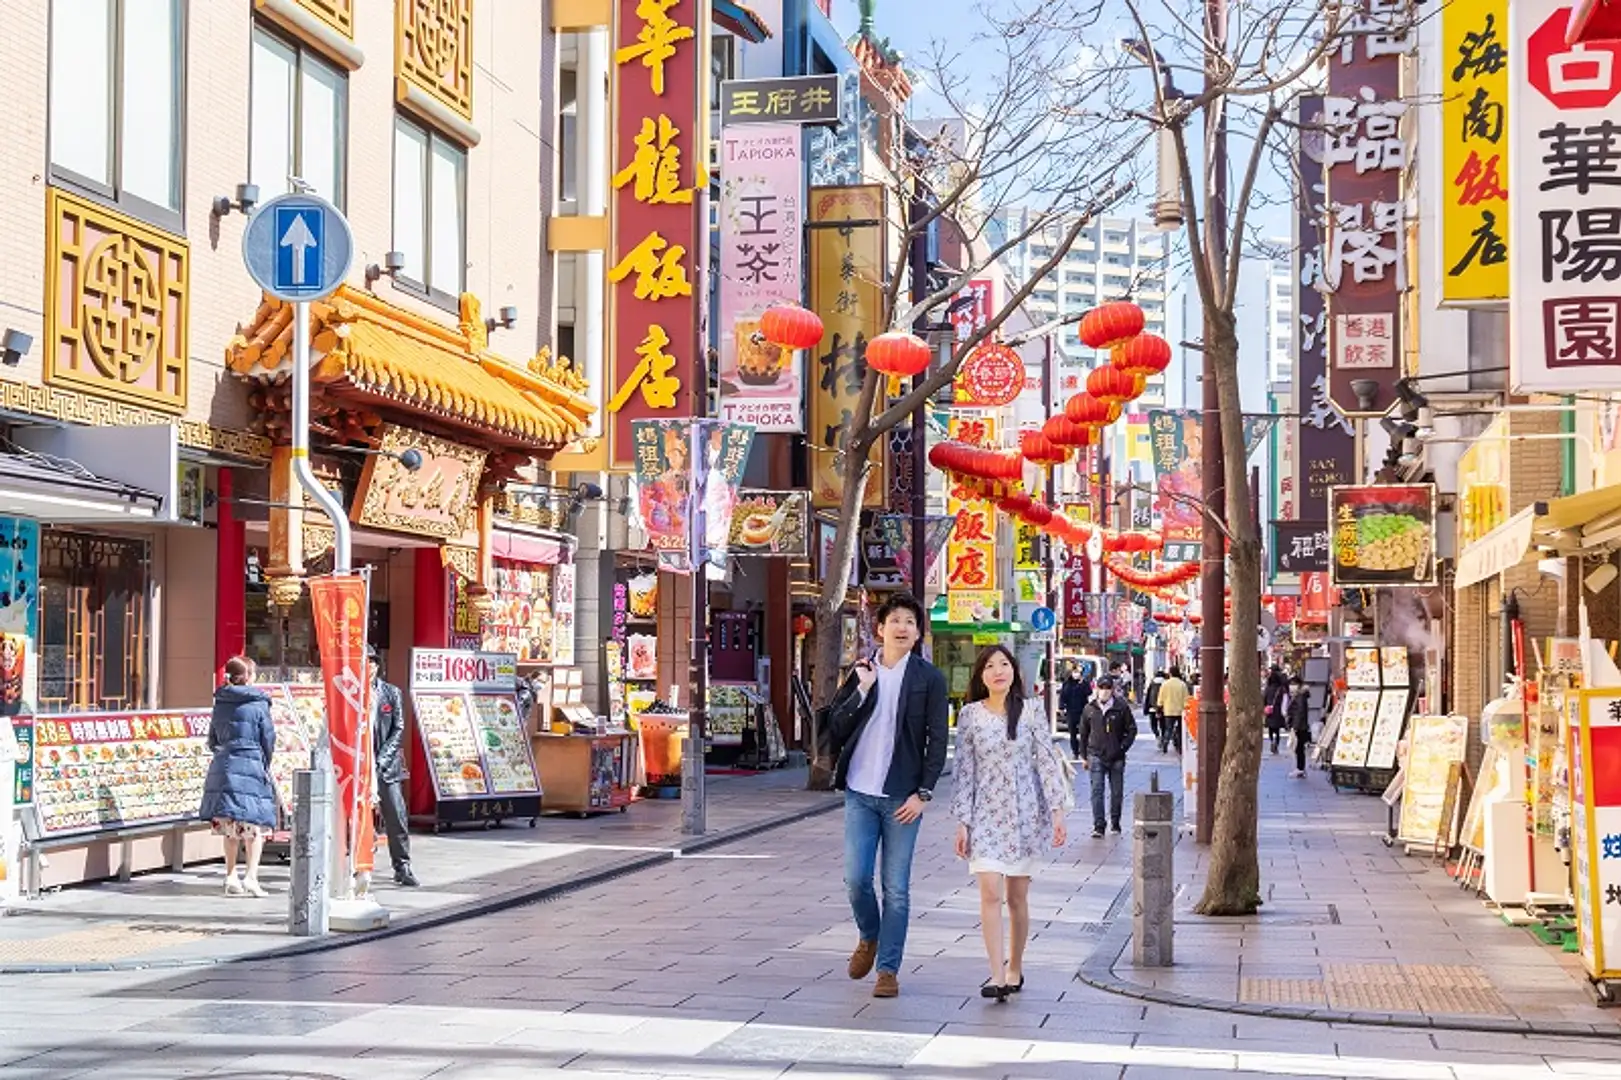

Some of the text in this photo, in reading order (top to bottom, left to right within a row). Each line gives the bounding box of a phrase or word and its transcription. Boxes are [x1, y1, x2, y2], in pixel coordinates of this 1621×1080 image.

[729, 86, 832, 115] 王府井
[726, 139, 796, 162] TAPIOKA
[1448, 14, 1509, 276] 海南飯店
[607, 0, 709, 413] 華龍飯店
[736, 196, 781, 284] 王茶
[1537, 120, 1621, 369] 華陽園
[1344, 317, 1390, 339] 香港
[1344, 343, 1388, 363] 飲茶
[636, 427, 662, 480] 媽祖祭
[1153, 415, 1178, 471] 媽祖祭
